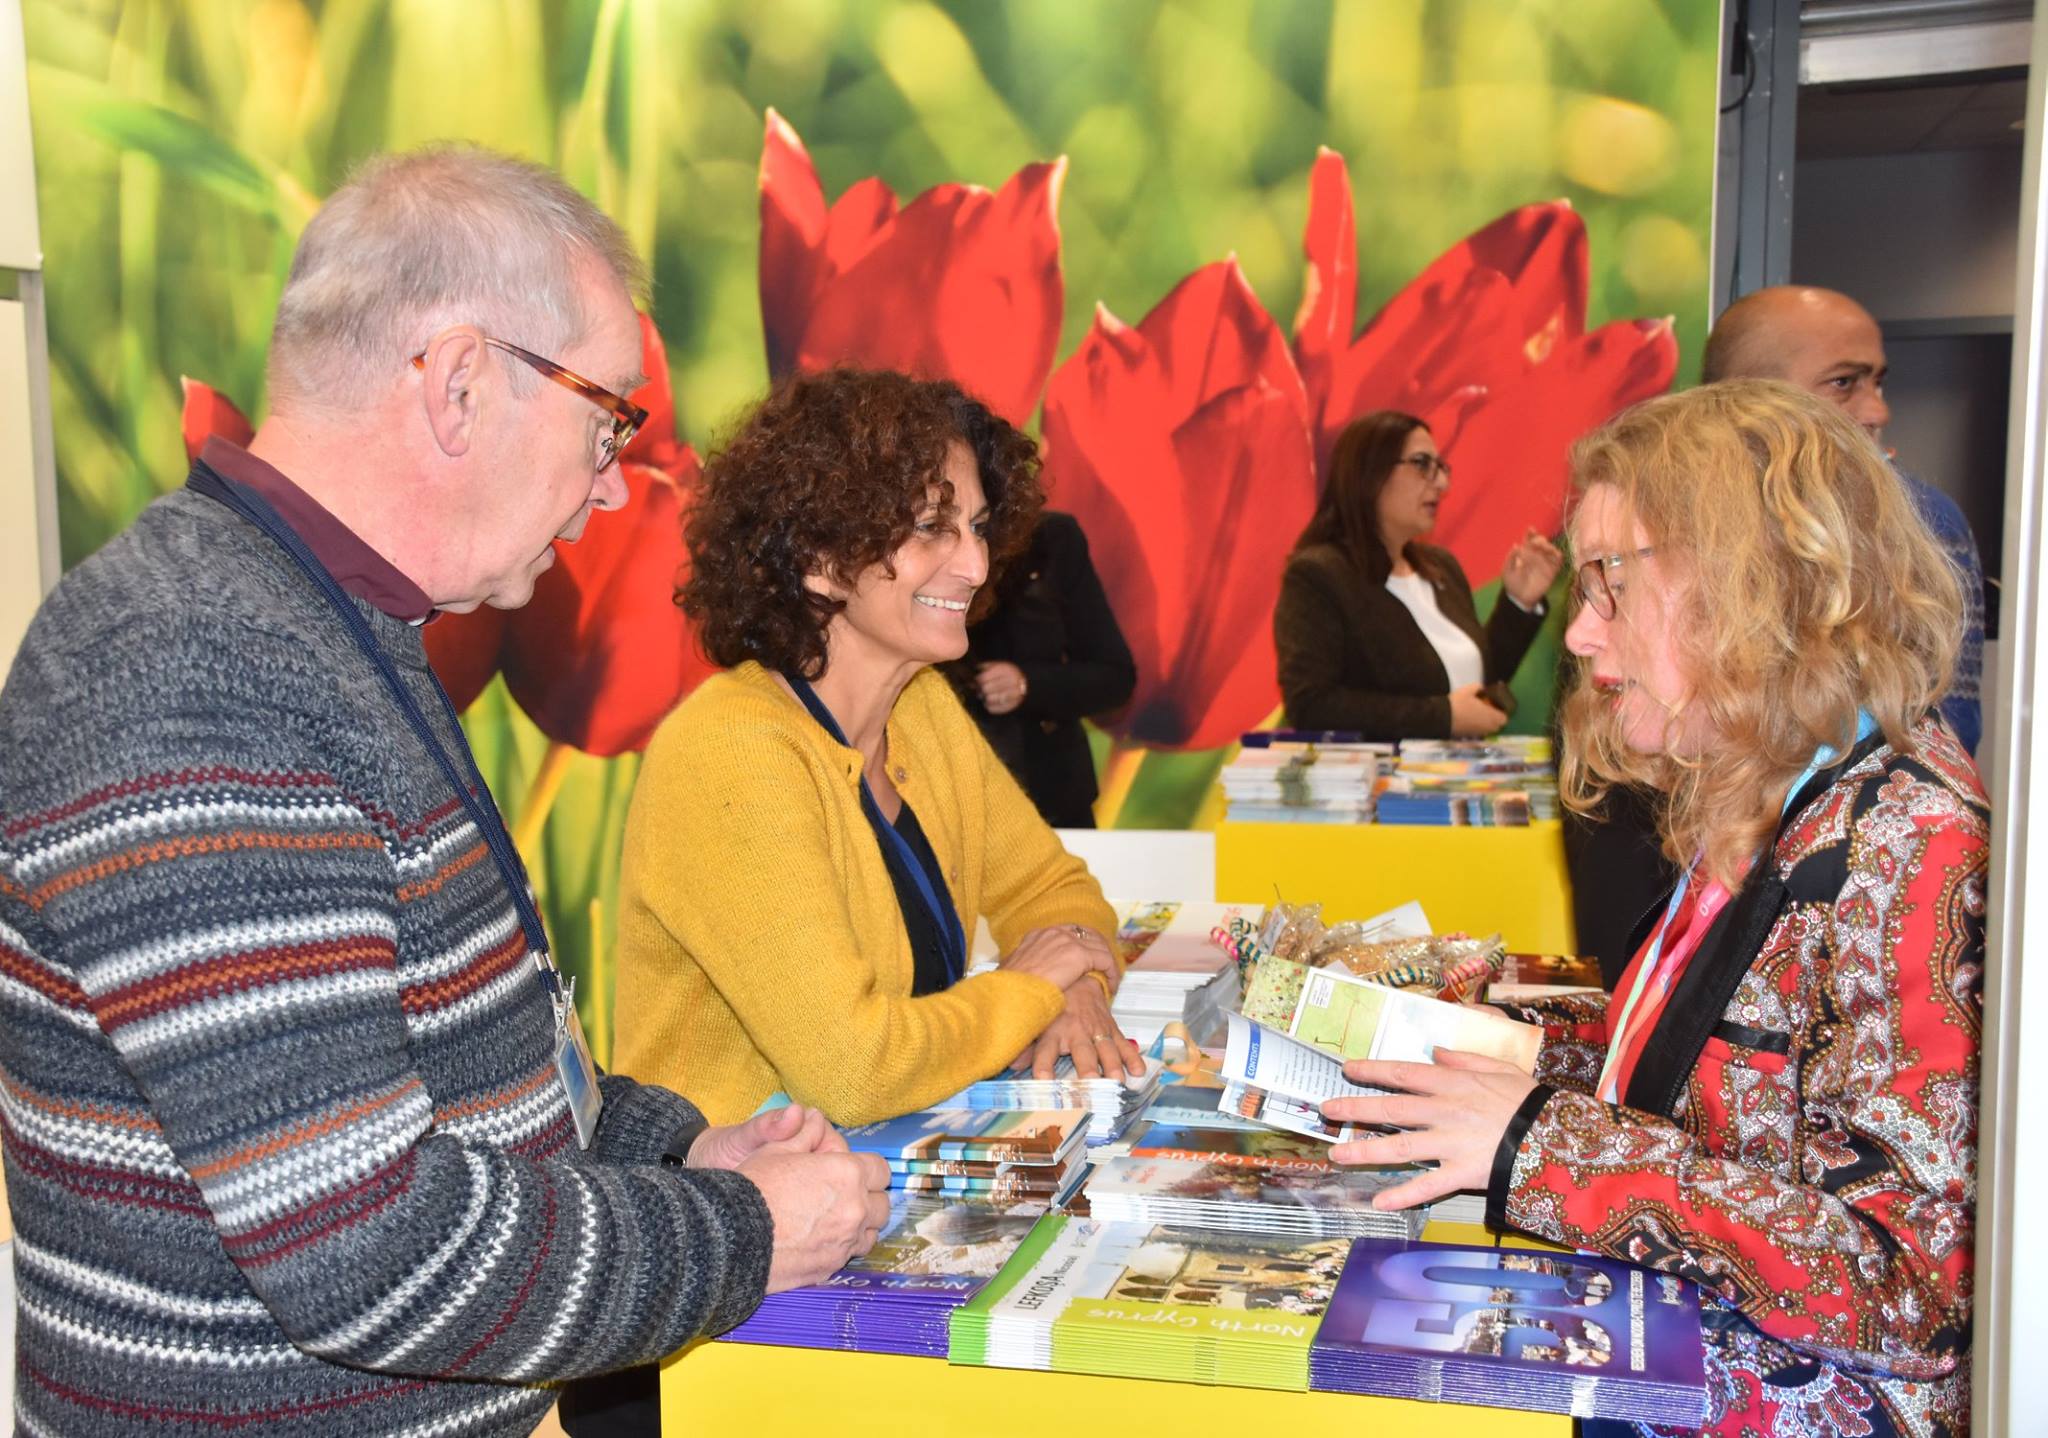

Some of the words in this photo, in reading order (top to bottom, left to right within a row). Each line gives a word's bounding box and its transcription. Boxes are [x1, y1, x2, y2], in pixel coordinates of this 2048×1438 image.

[1247, 1043, 1260, 1077] CONTENTS
[881, 1279, 970, 1290] North
[1013, 1275, 1066, 1310] LEFKOŞA
[1087, 1307, 1197, 1328] Cyprus
[1210, 1318, 1306, 1337] North
